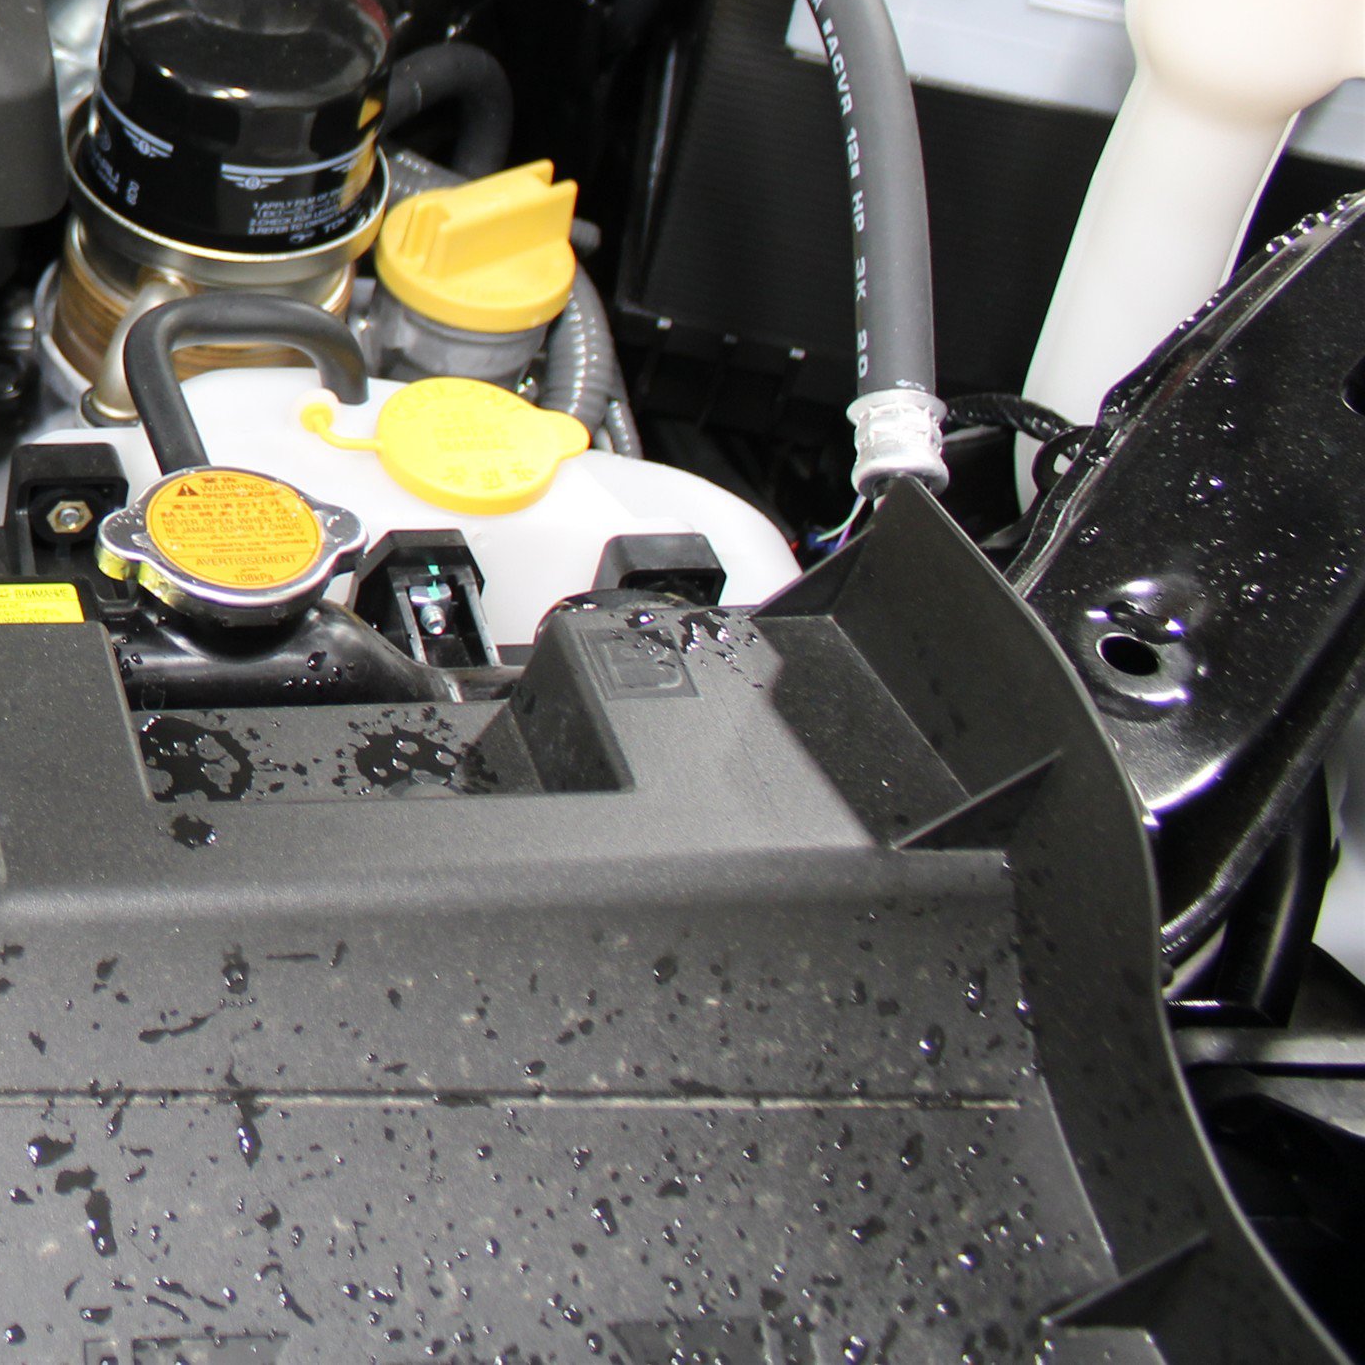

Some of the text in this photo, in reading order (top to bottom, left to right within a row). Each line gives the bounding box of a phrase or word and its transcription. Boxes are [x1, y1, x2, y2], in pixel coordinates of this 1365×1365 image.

[852, 189, 866, 233] HP
[855, 256, 867, 302] 3K
[857, 329, 869, 379] 20
[200, 482, 266, 493] WARNING
[162, 517, 199, 527] NEVER
[203, 516, 234, 526] OPEN
[238, 515, 271, 525] WHEN
[165, 526, 177, 534] NE
[182, 525, 216, 534] JAMAIS
[219, 523, 255, 533] OUVRIR
[196, 555, 297, 566] AVERTISSEMENT
[234, 573, 277, 583] 108kPa
